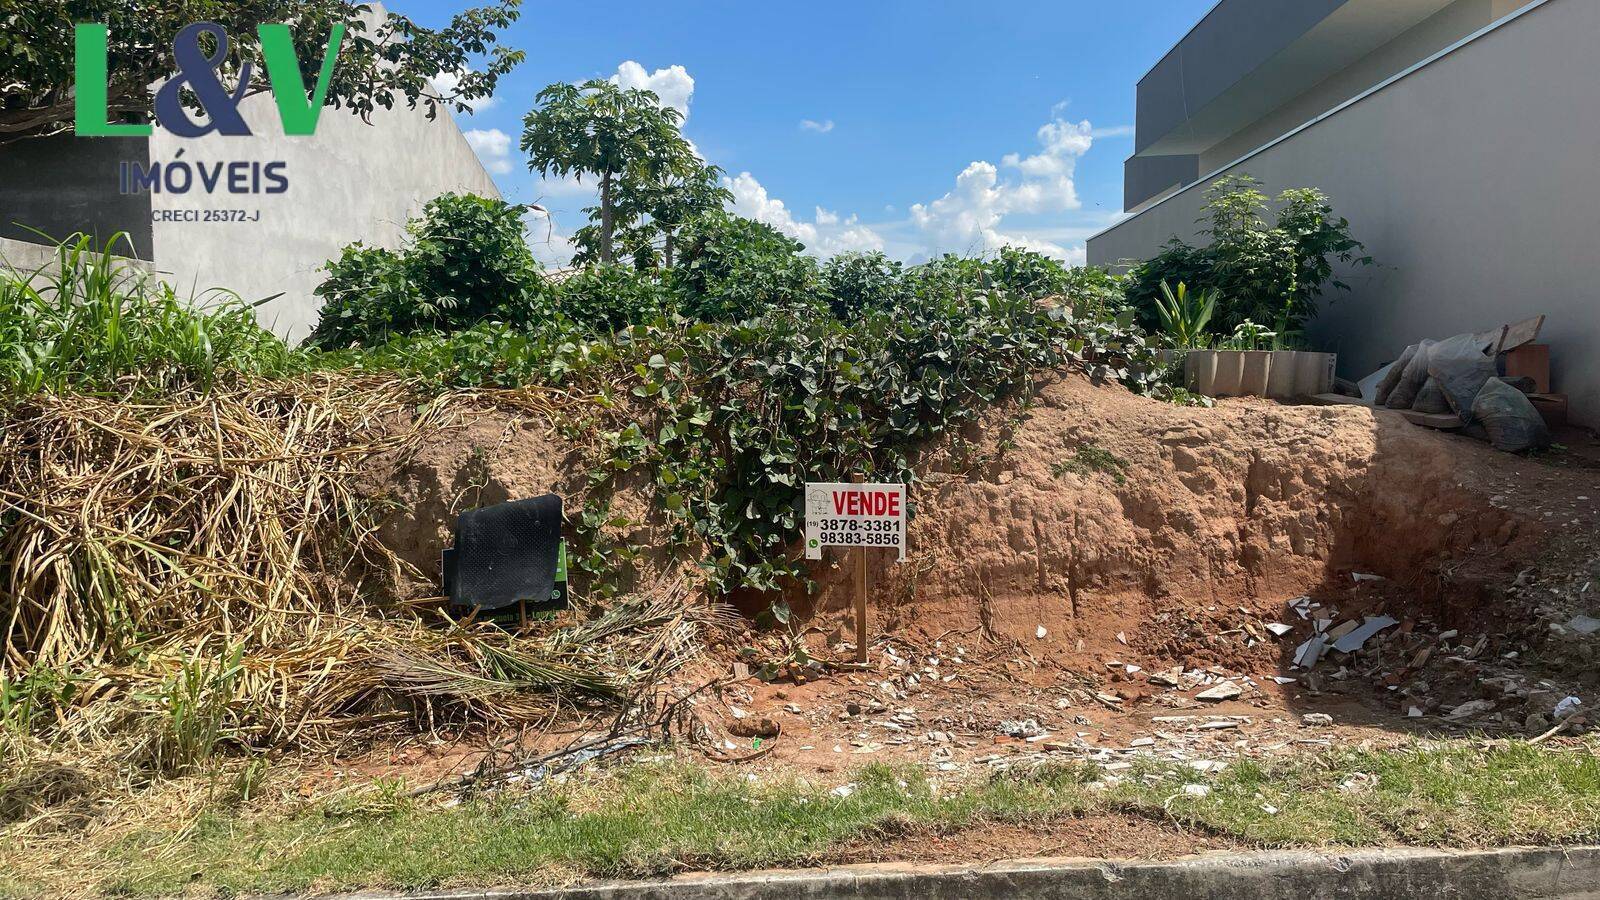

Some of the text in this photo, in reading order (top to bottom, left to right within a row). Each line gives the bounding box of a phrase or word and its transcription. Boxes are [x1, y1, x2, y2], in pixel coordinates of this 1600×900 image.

[833, 491, 900, 516] VENDE
[820, 519, 900, 532] 3878-3381
[820, 532, 900, 545] 98383-5856
